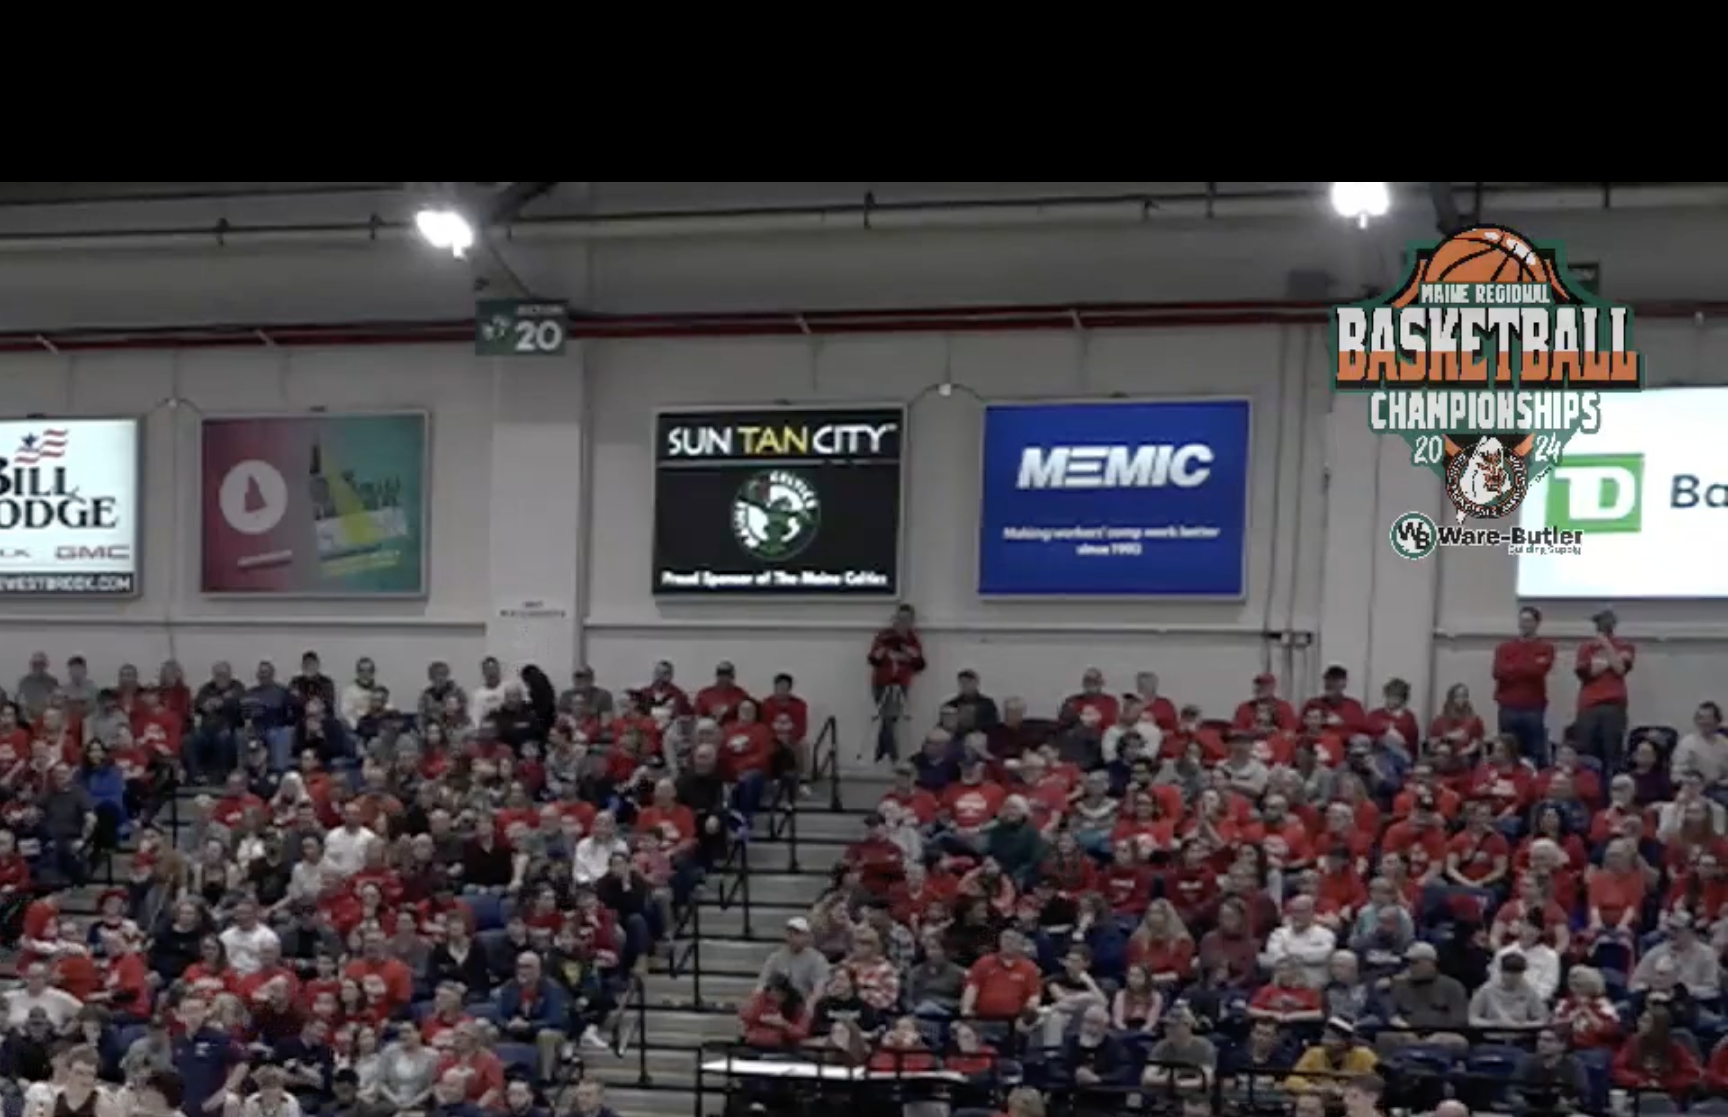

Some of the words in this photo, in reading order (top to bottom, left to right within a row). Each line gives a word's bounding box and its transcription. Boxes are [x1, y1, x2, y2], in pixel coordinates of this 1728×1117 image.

[514, 320, 563, 350] 20
[668, 426, 733, 456] SUN
[737, 426, 808, 455] TAN
[812, 423, 886, 454] CITY
[1017, 443, 1215, 488] MEMIC
[1554, 466, 1635, 519] TD
